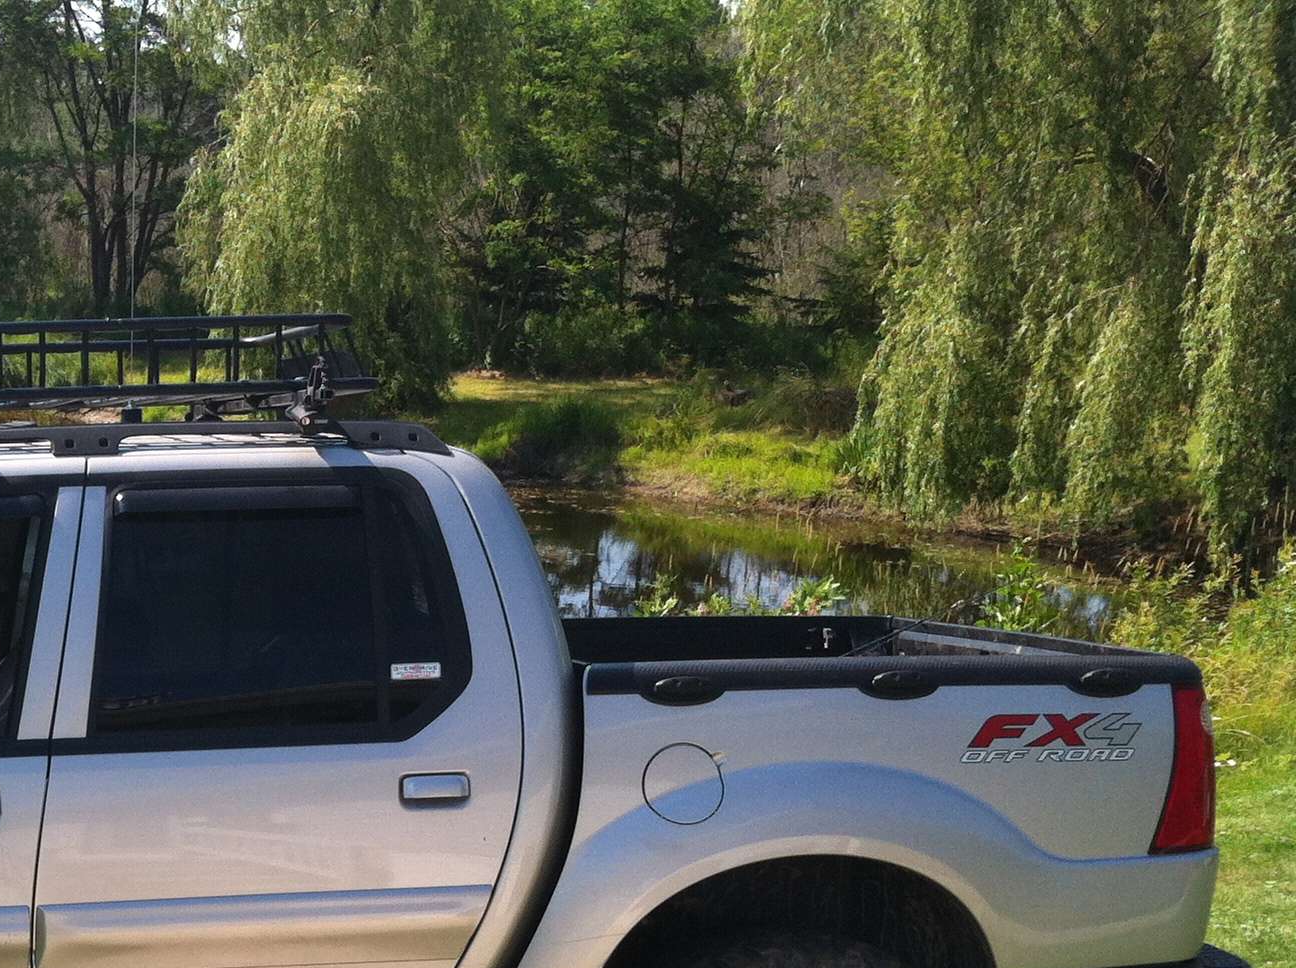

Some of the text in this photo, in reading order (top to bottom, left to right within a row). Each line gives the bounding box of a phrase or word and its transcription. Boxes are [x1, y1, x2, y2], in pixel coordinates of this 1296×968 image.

[967, 712, 1142, 748] FX4
[960, 747, 1136, 764] OFF ROAD
